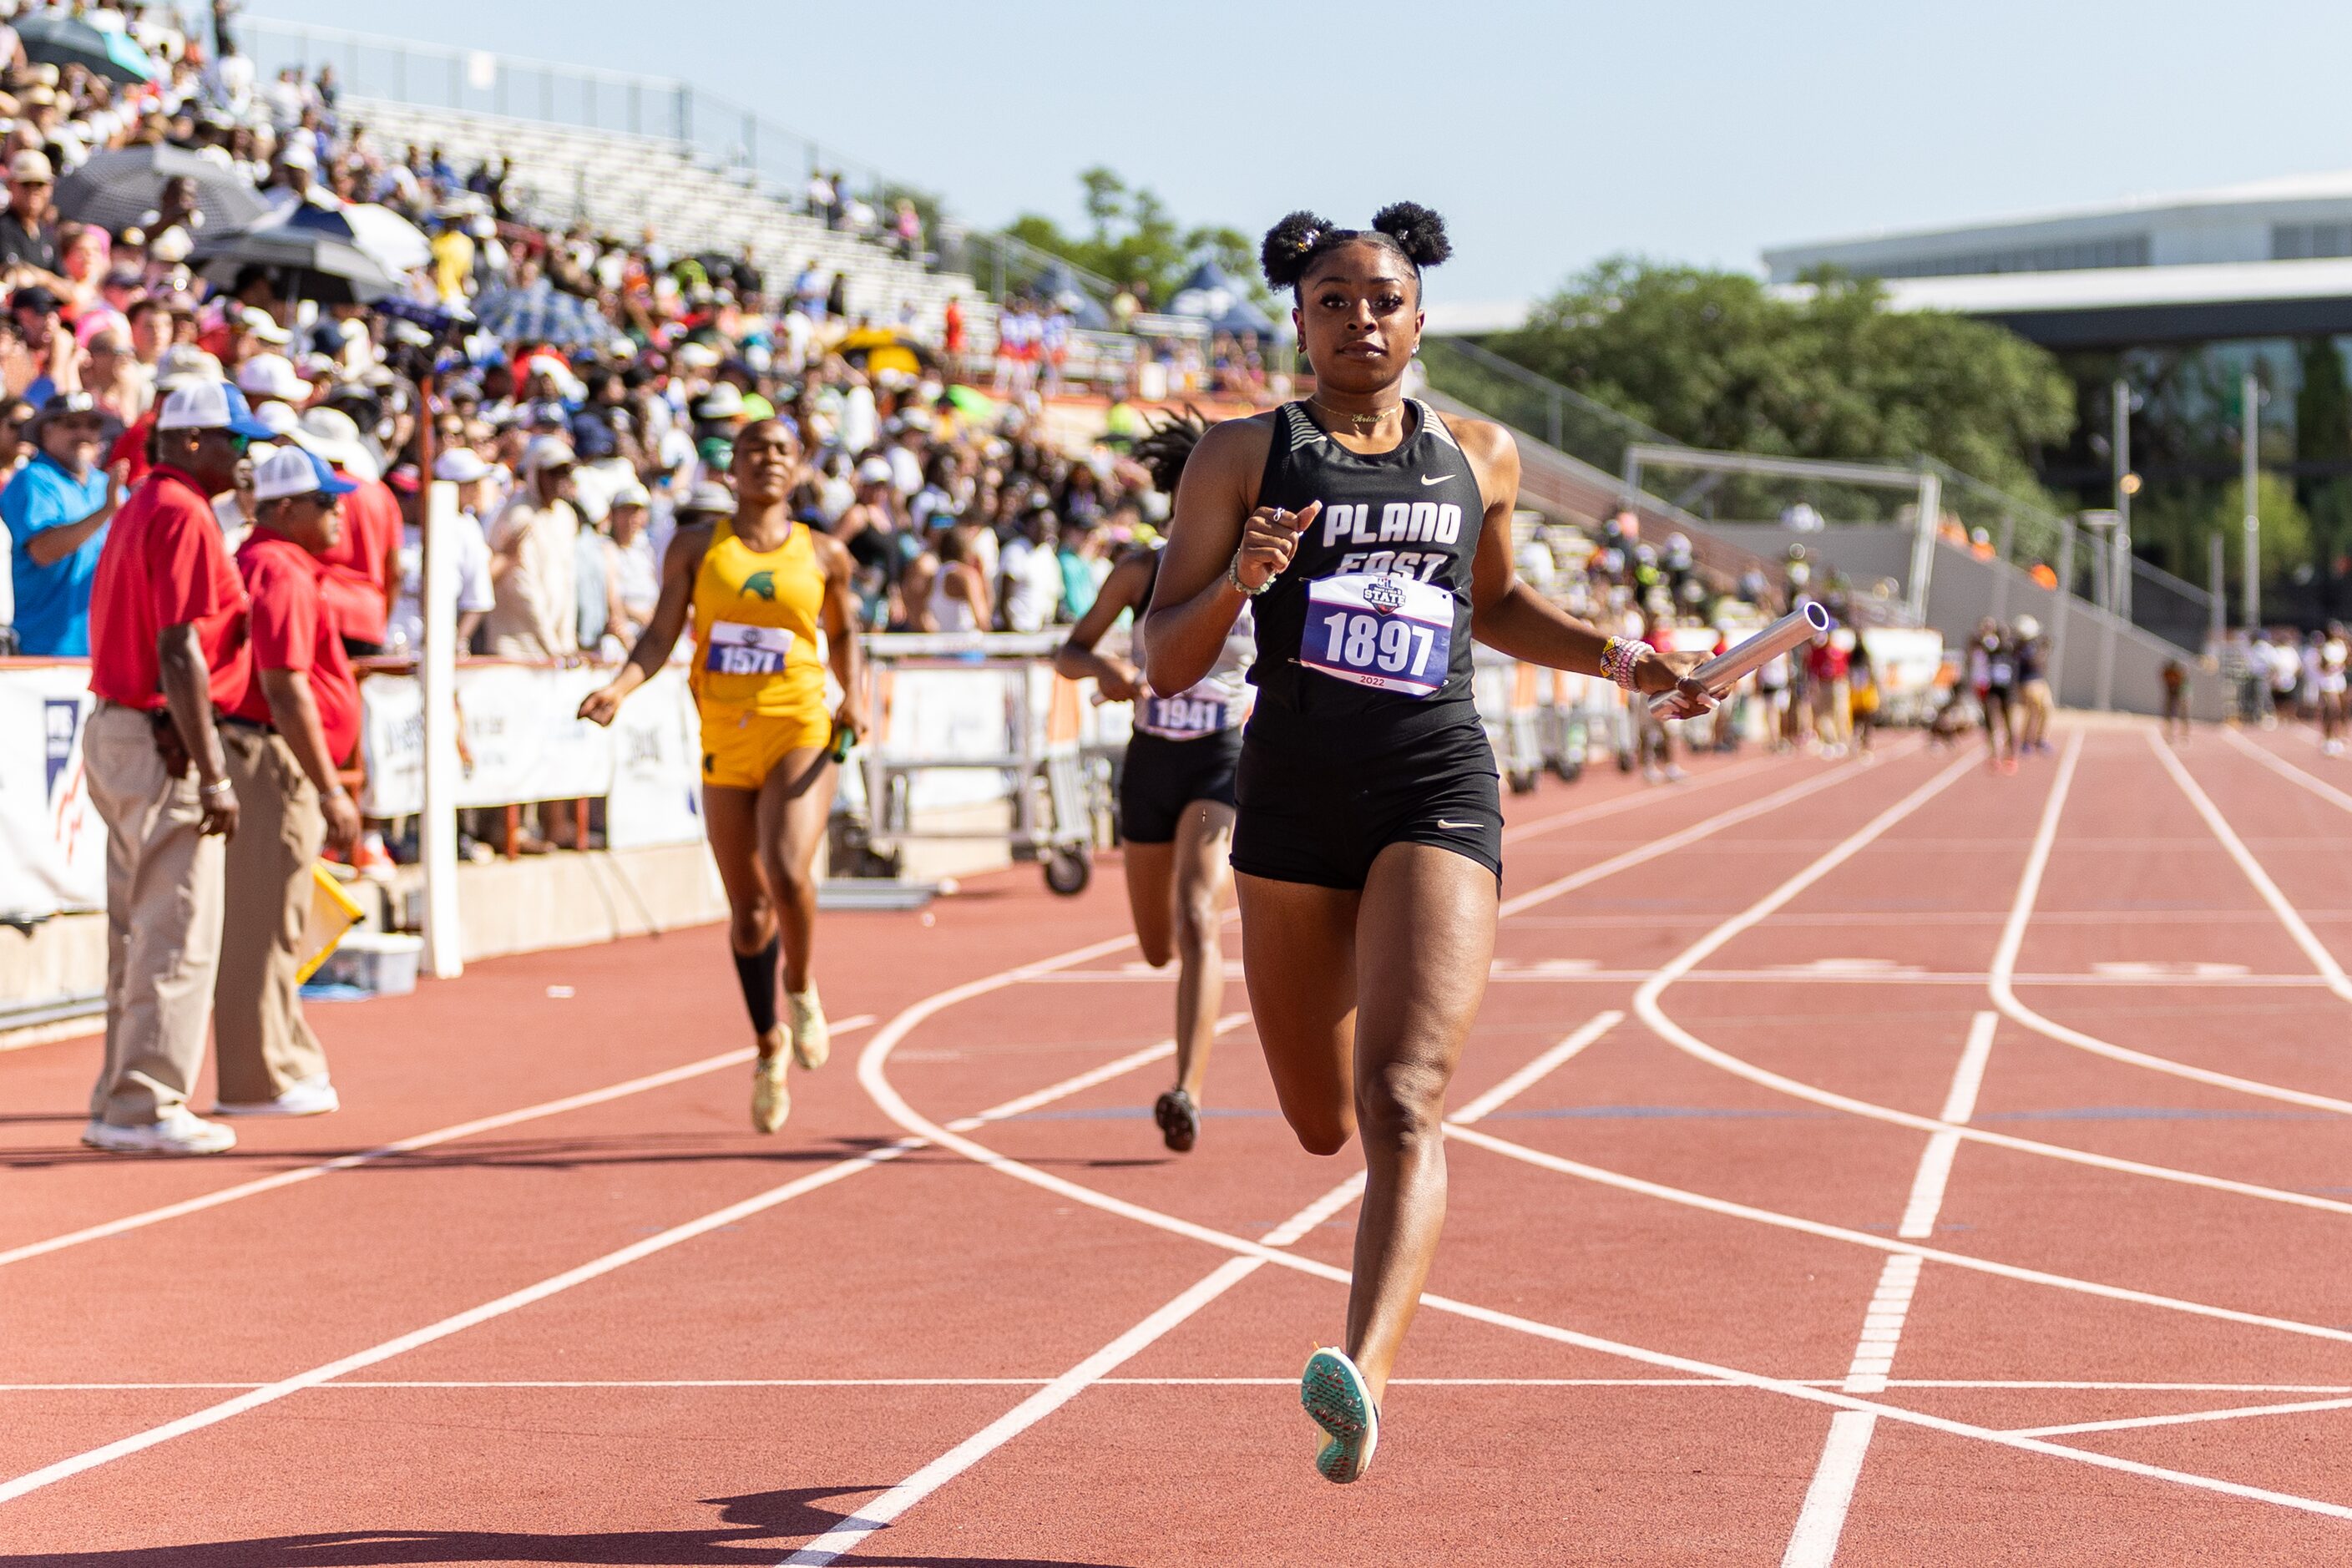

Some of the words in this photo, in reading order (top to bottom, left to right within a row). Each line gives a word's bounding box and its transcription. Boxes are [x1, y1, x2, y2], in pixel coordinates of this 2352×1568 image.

[1323, 502, 1461, 548] PLANO
[1363, 589, 1406, 607] STATE
[1323, 612, 1435, 677] 1897
[721, 646, 777, 675] 1571
[1359, 675, 1384, 687] 2022
[1156, 698, 1218, 731] 1941
